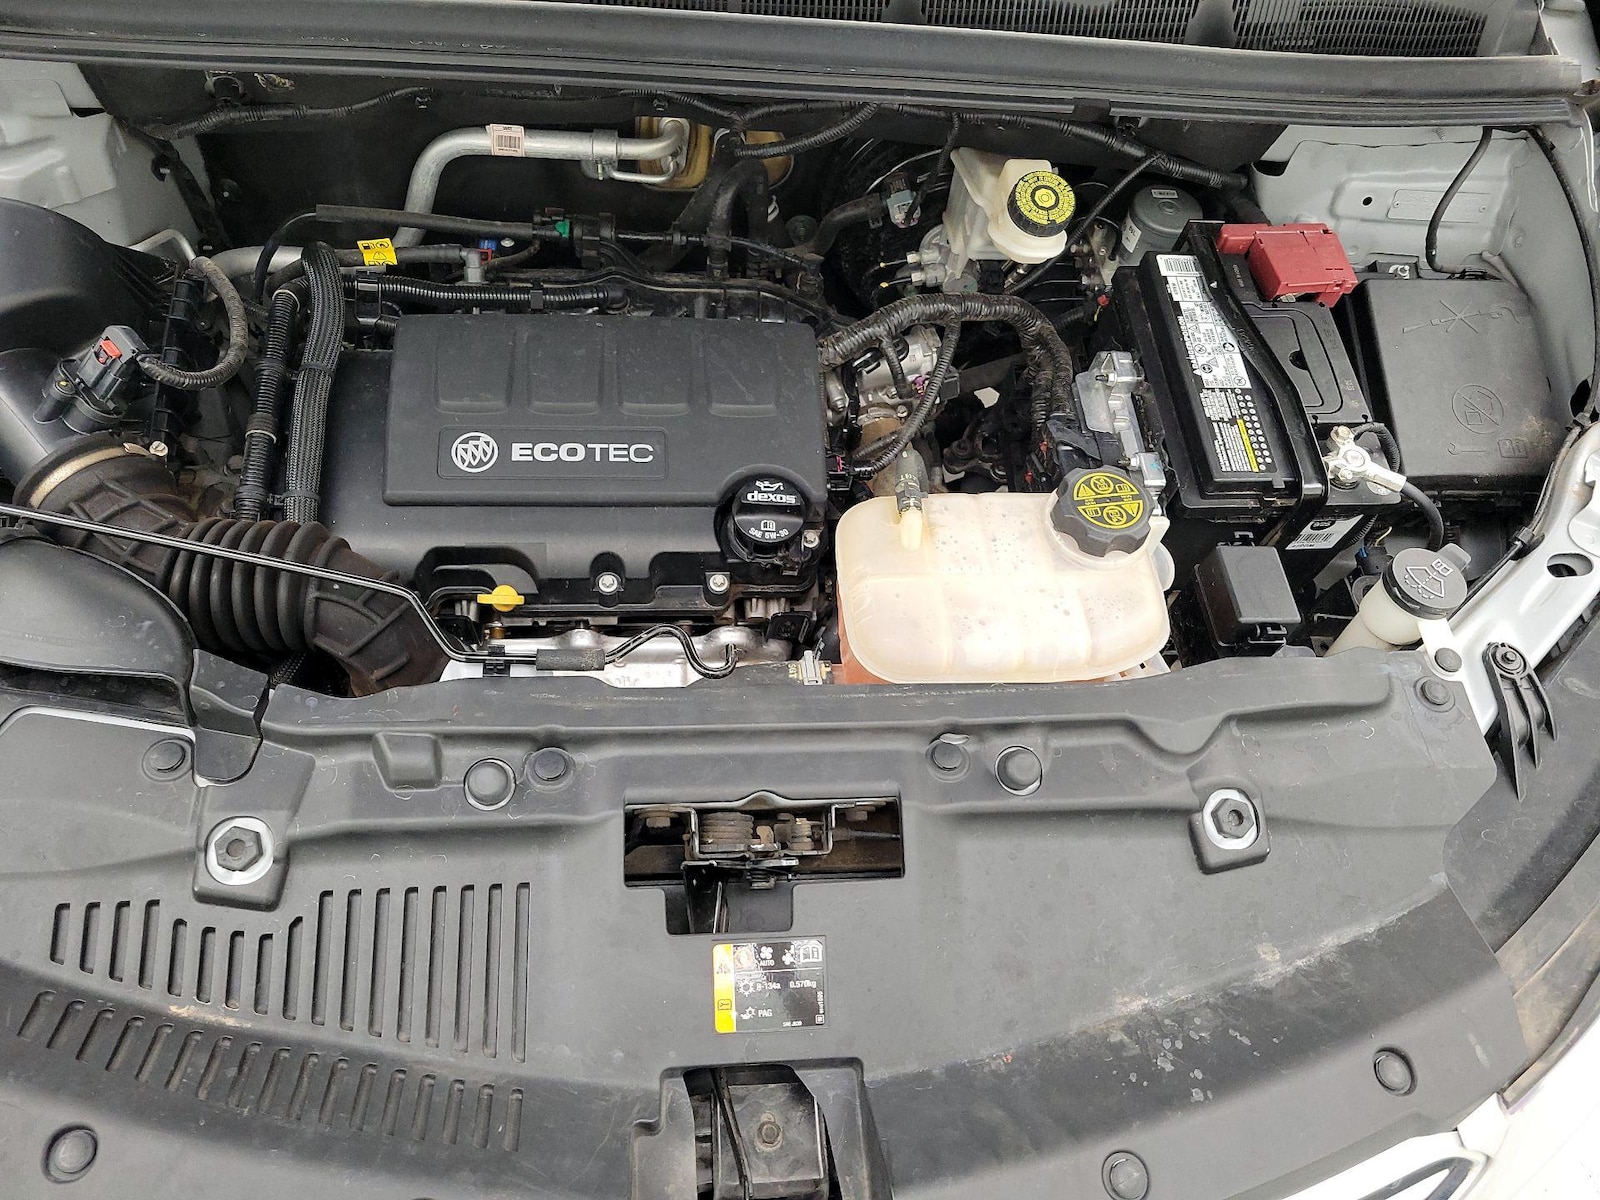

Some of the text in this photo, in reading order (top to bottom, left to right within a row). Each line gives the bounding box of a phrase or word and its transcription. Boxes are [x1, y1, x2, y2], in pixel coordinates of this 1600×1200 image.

[511, 443, 654, 463] ECOTEC
[747, 490, 797, 504] dexos
[749, 527, 789, 539] SAE 5W-30
[760, 959, 775, 967] AUTO
[758, 1009, 773, 1018] PAG
